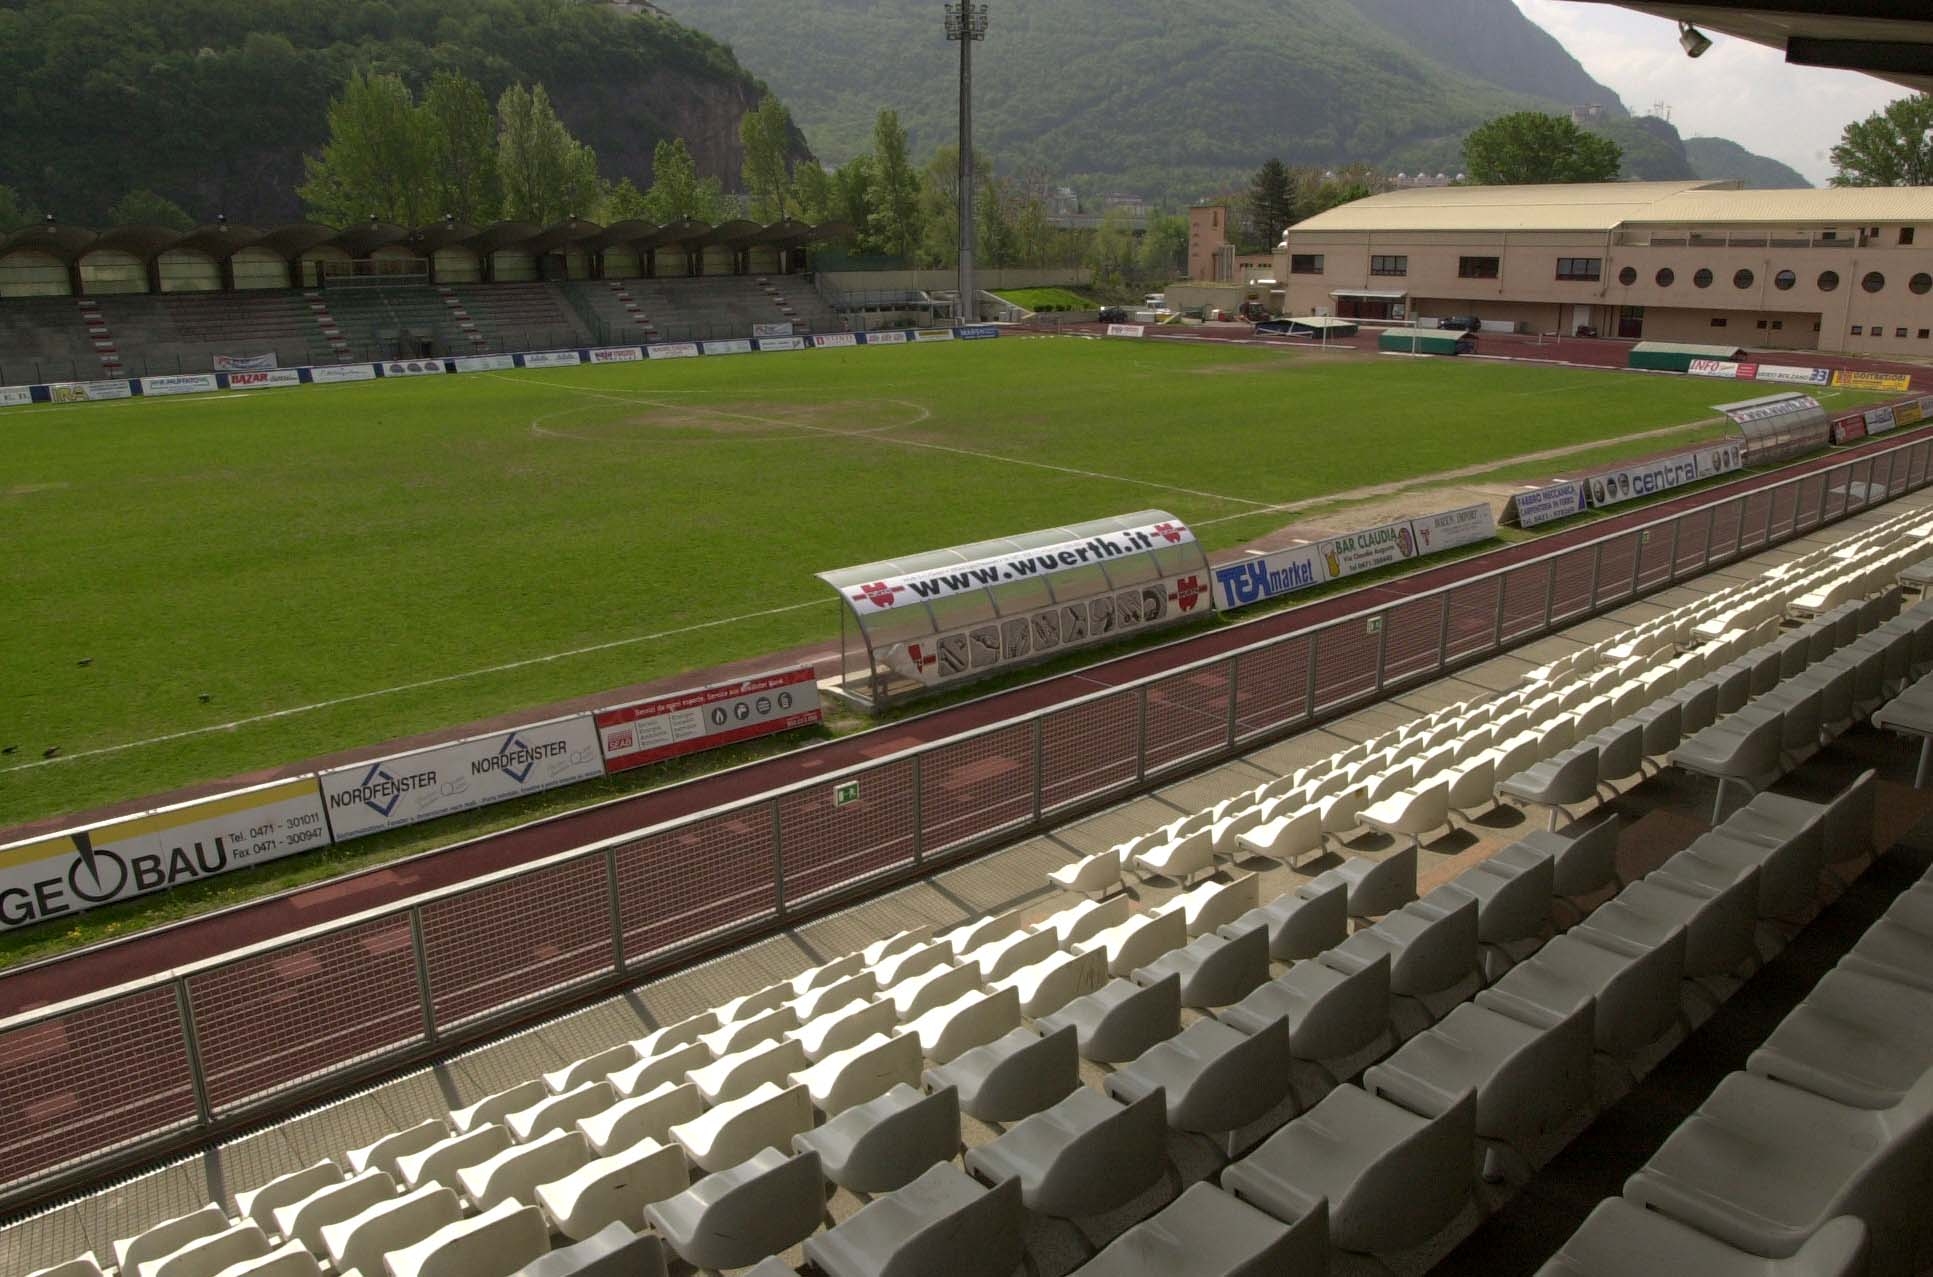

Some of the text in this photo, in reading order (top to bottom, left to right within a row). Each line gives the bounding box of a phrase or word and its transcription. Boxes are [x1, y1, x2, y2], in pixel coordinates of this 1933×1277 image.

[231, 373, 268, 385] BAZAR
[1691, 359, 1719, 372] INFO
[1633, 454, 1698, 494] central
[1335, 528, 1396, 554] BAR CLAUDIA
[909, 531, 1153, 598] www.wuerth.it
[470, 740, 567, 776] NORDFENSTER
[330, 771, 437, 809] NORDFENSTER
[229, 832, 247, 843] Tel.
[250, 823, 274, 840] 0471
[286, 812, 319, 830] 301011
[232, 848, 251, 861] Fax
[253, 840, 277, 856] 0471
[287, 827, 323, 846] 300947
